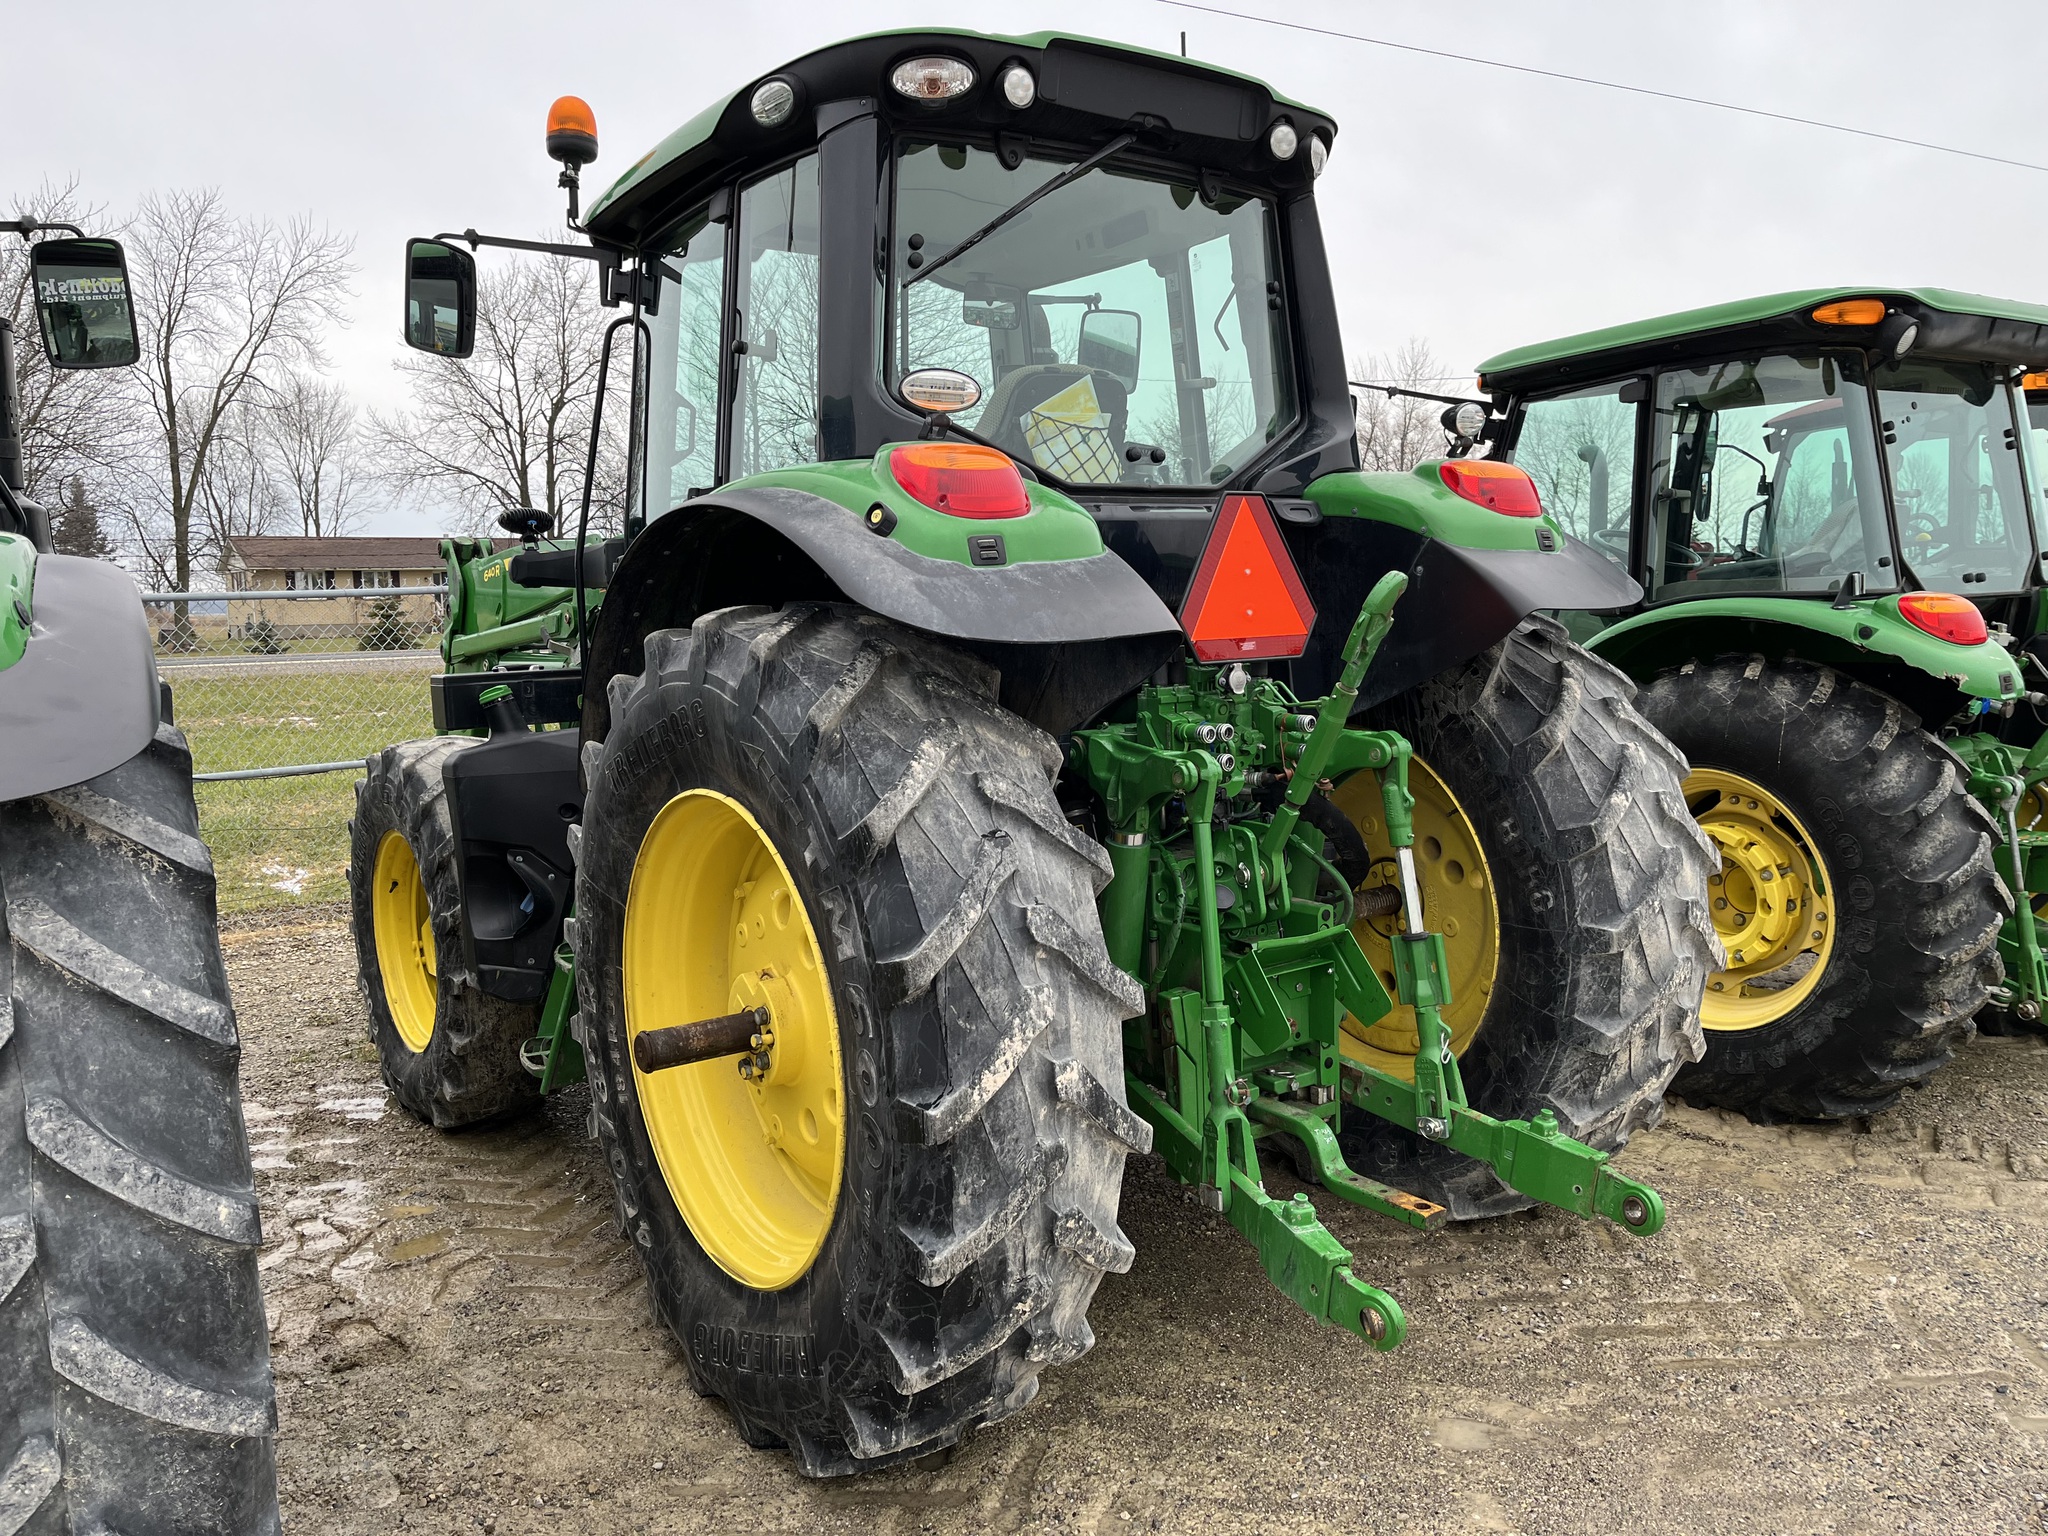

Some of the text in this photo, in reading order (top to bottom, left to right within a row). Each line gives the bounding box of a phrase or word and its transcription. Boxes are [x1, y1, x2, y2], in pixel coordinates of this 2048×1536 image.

[483, 564, 501, 583] 640R
[604, 698, 708, 796] TRELLEBORG
[693, 1321, 825, 1380] TRELLEBORG
